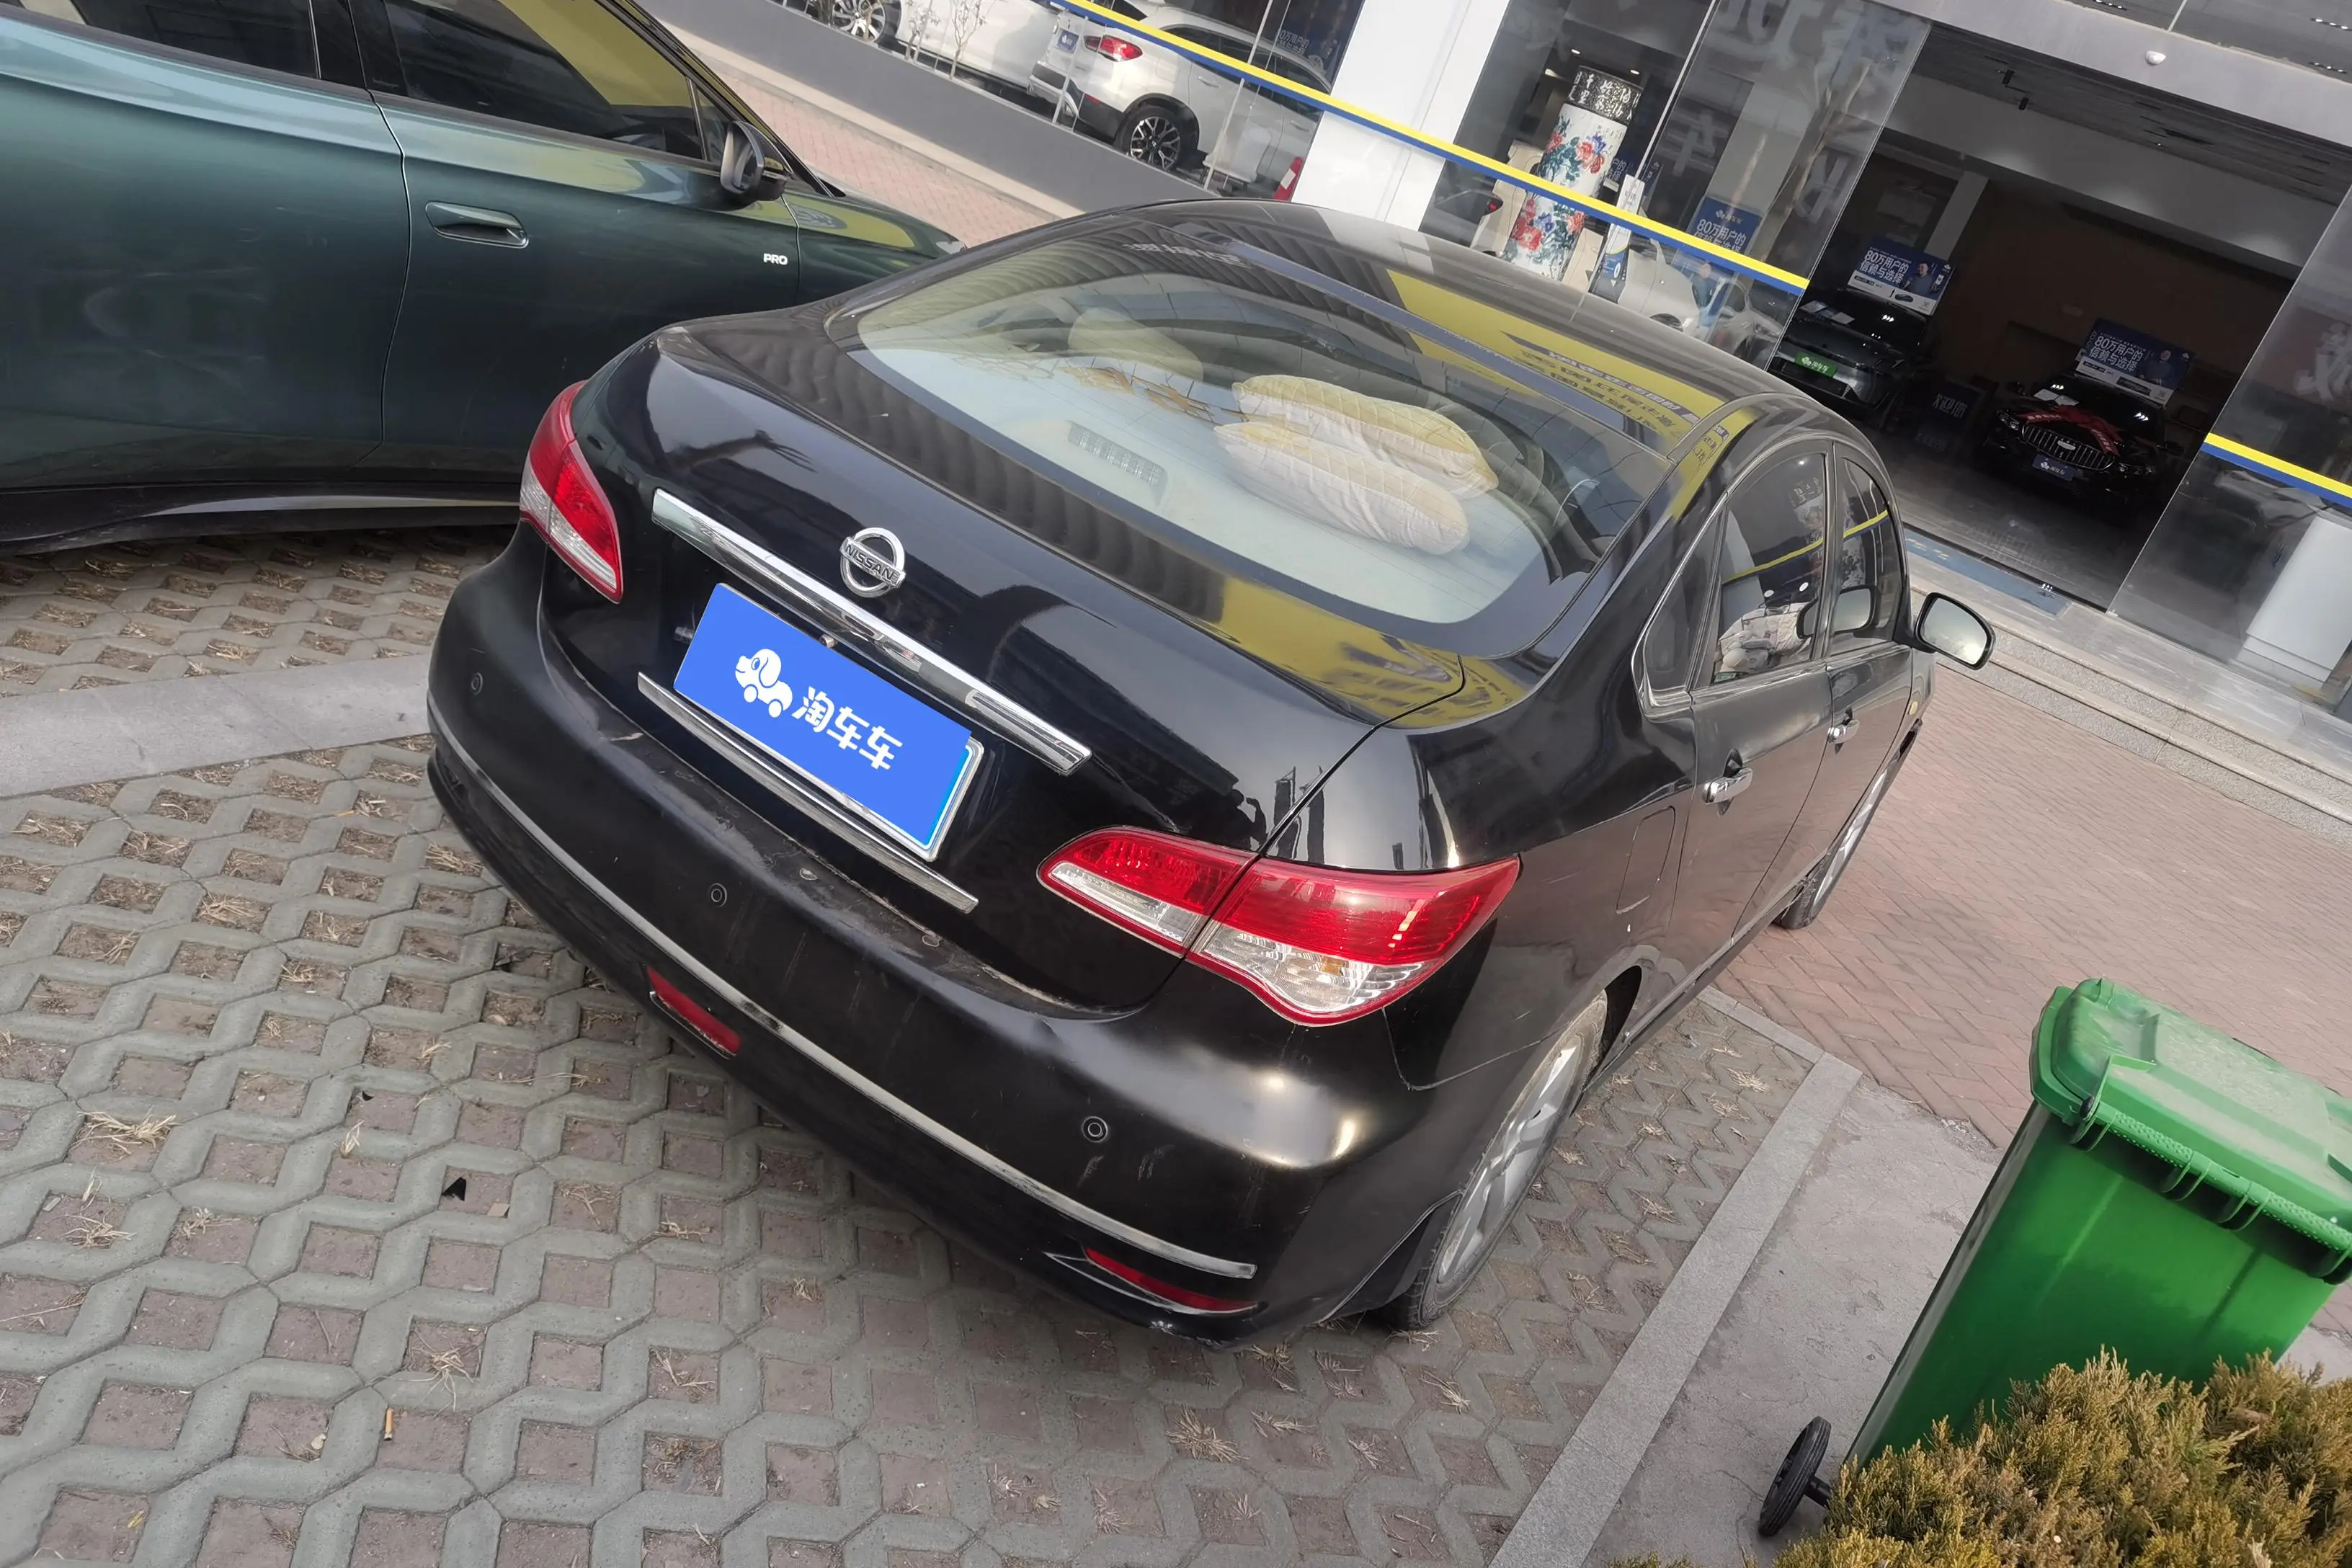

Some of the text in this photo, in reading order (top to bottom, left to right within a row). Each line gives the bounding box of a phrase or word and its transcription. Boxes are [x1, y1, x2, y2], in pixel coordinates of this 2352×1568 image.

[1696, 219, 1747, 246] 80万用户的
[763, 253, 788, 266] PRO
[1864, 249, 1910, 275] 80万用户的
[2094, 335, 2144, 361] 80万用户的
[845, 544, 895, 580] NISSAN
